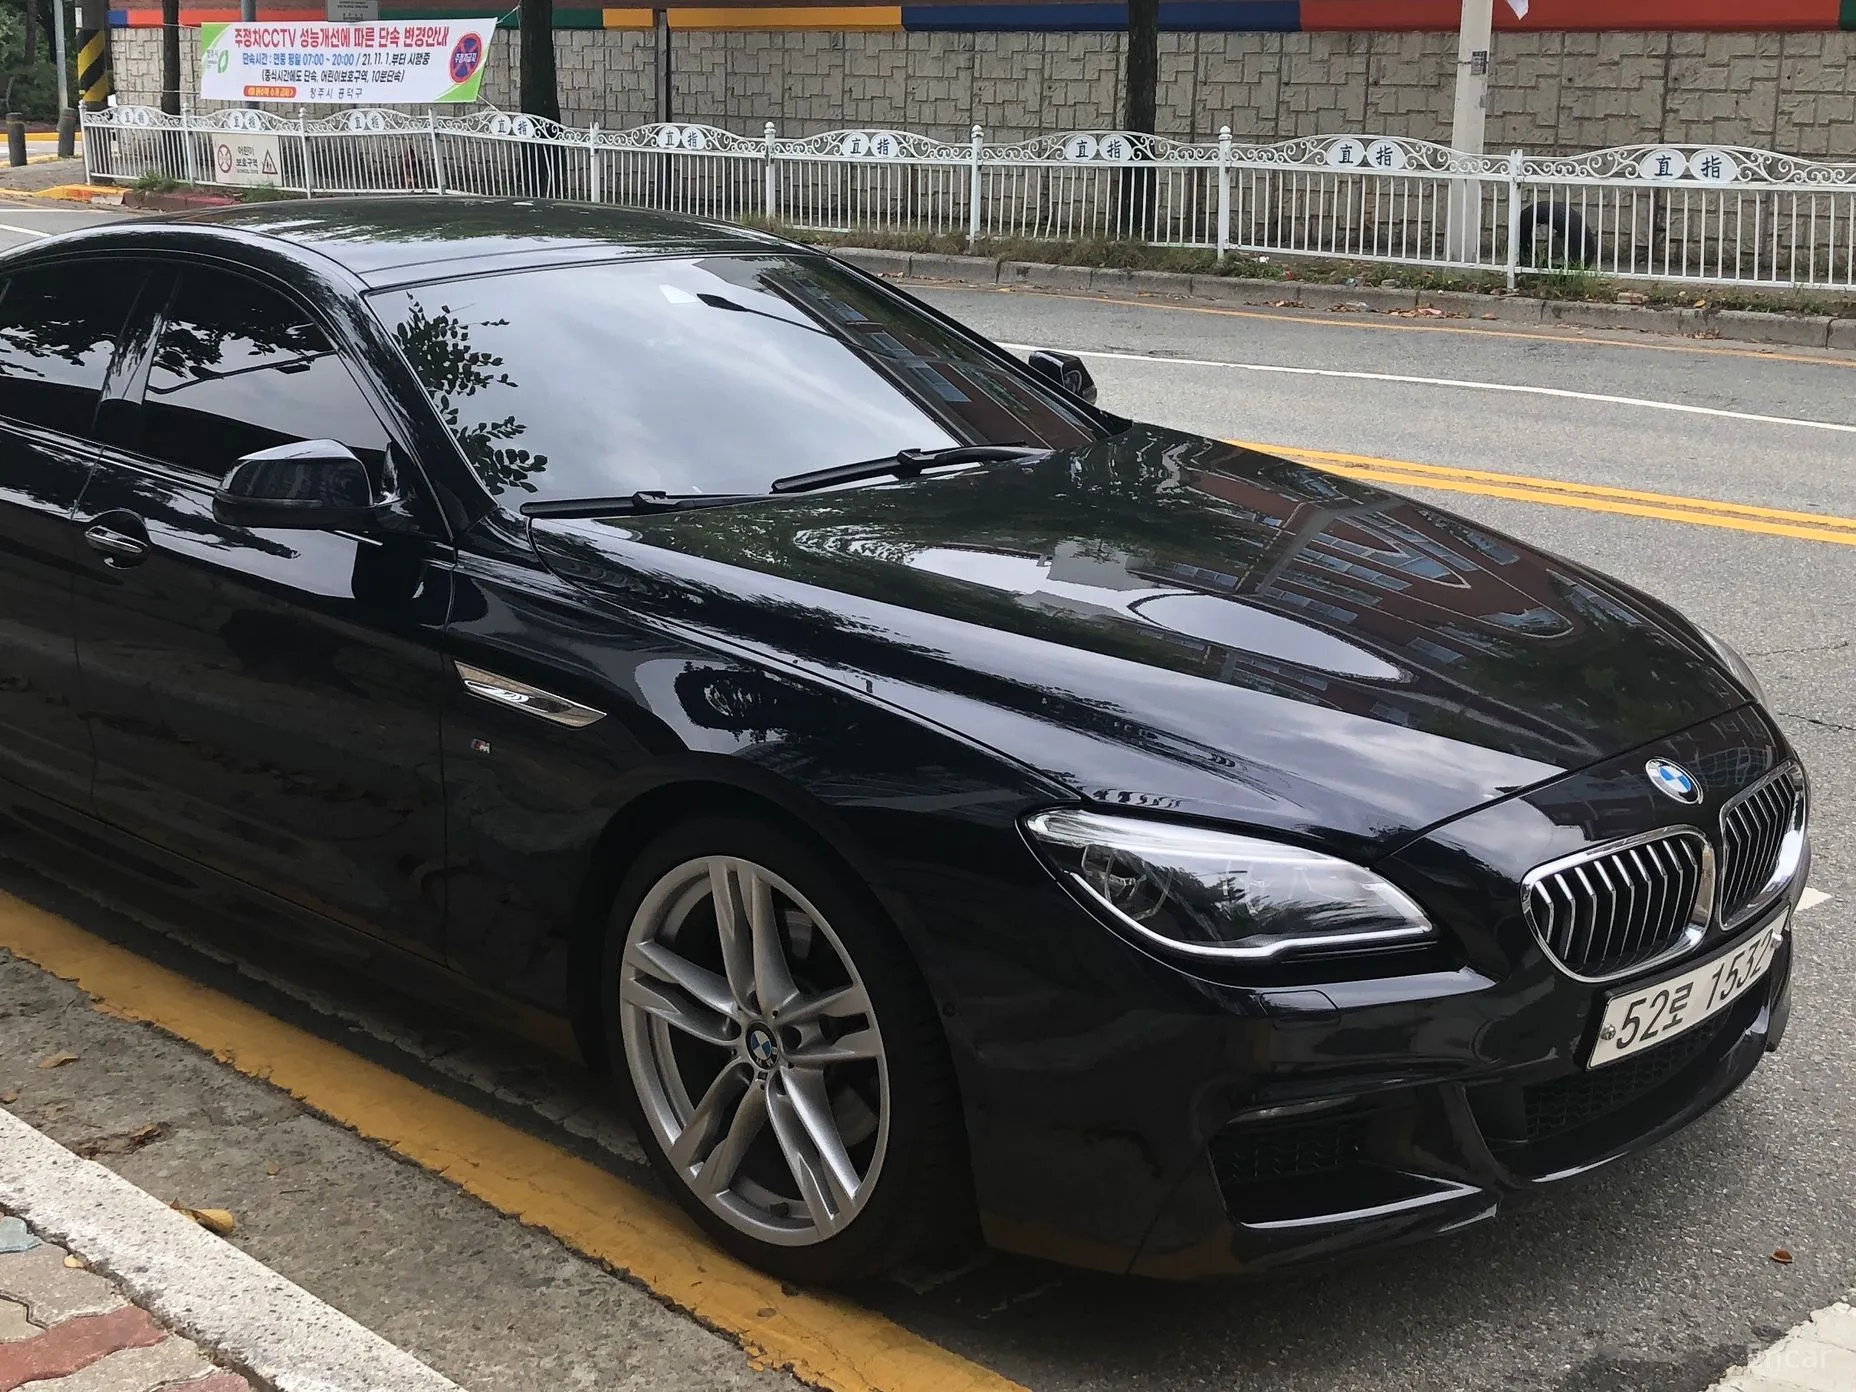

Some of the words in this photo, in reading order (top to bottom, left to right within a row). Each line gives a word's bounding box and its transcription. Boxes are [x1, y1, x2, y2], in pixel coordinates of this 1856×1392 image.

[235, 28, 296, 48] 주정차CCTV
[300, 28, 350, 48] 성능개선에
[354, 27, 374, 48] 따른
[379, 27, 400, 48] 단속
[404, 26, 449, 48] 변경안내
[243, 53, 268, 65] 단속시간
[303, 53, 324, 66] 07:00
[332, 53, 354, 66] 20:00
[1616, 982, 1694, 1050] 52로
[1706, 929, 1773, 1011] 1532
